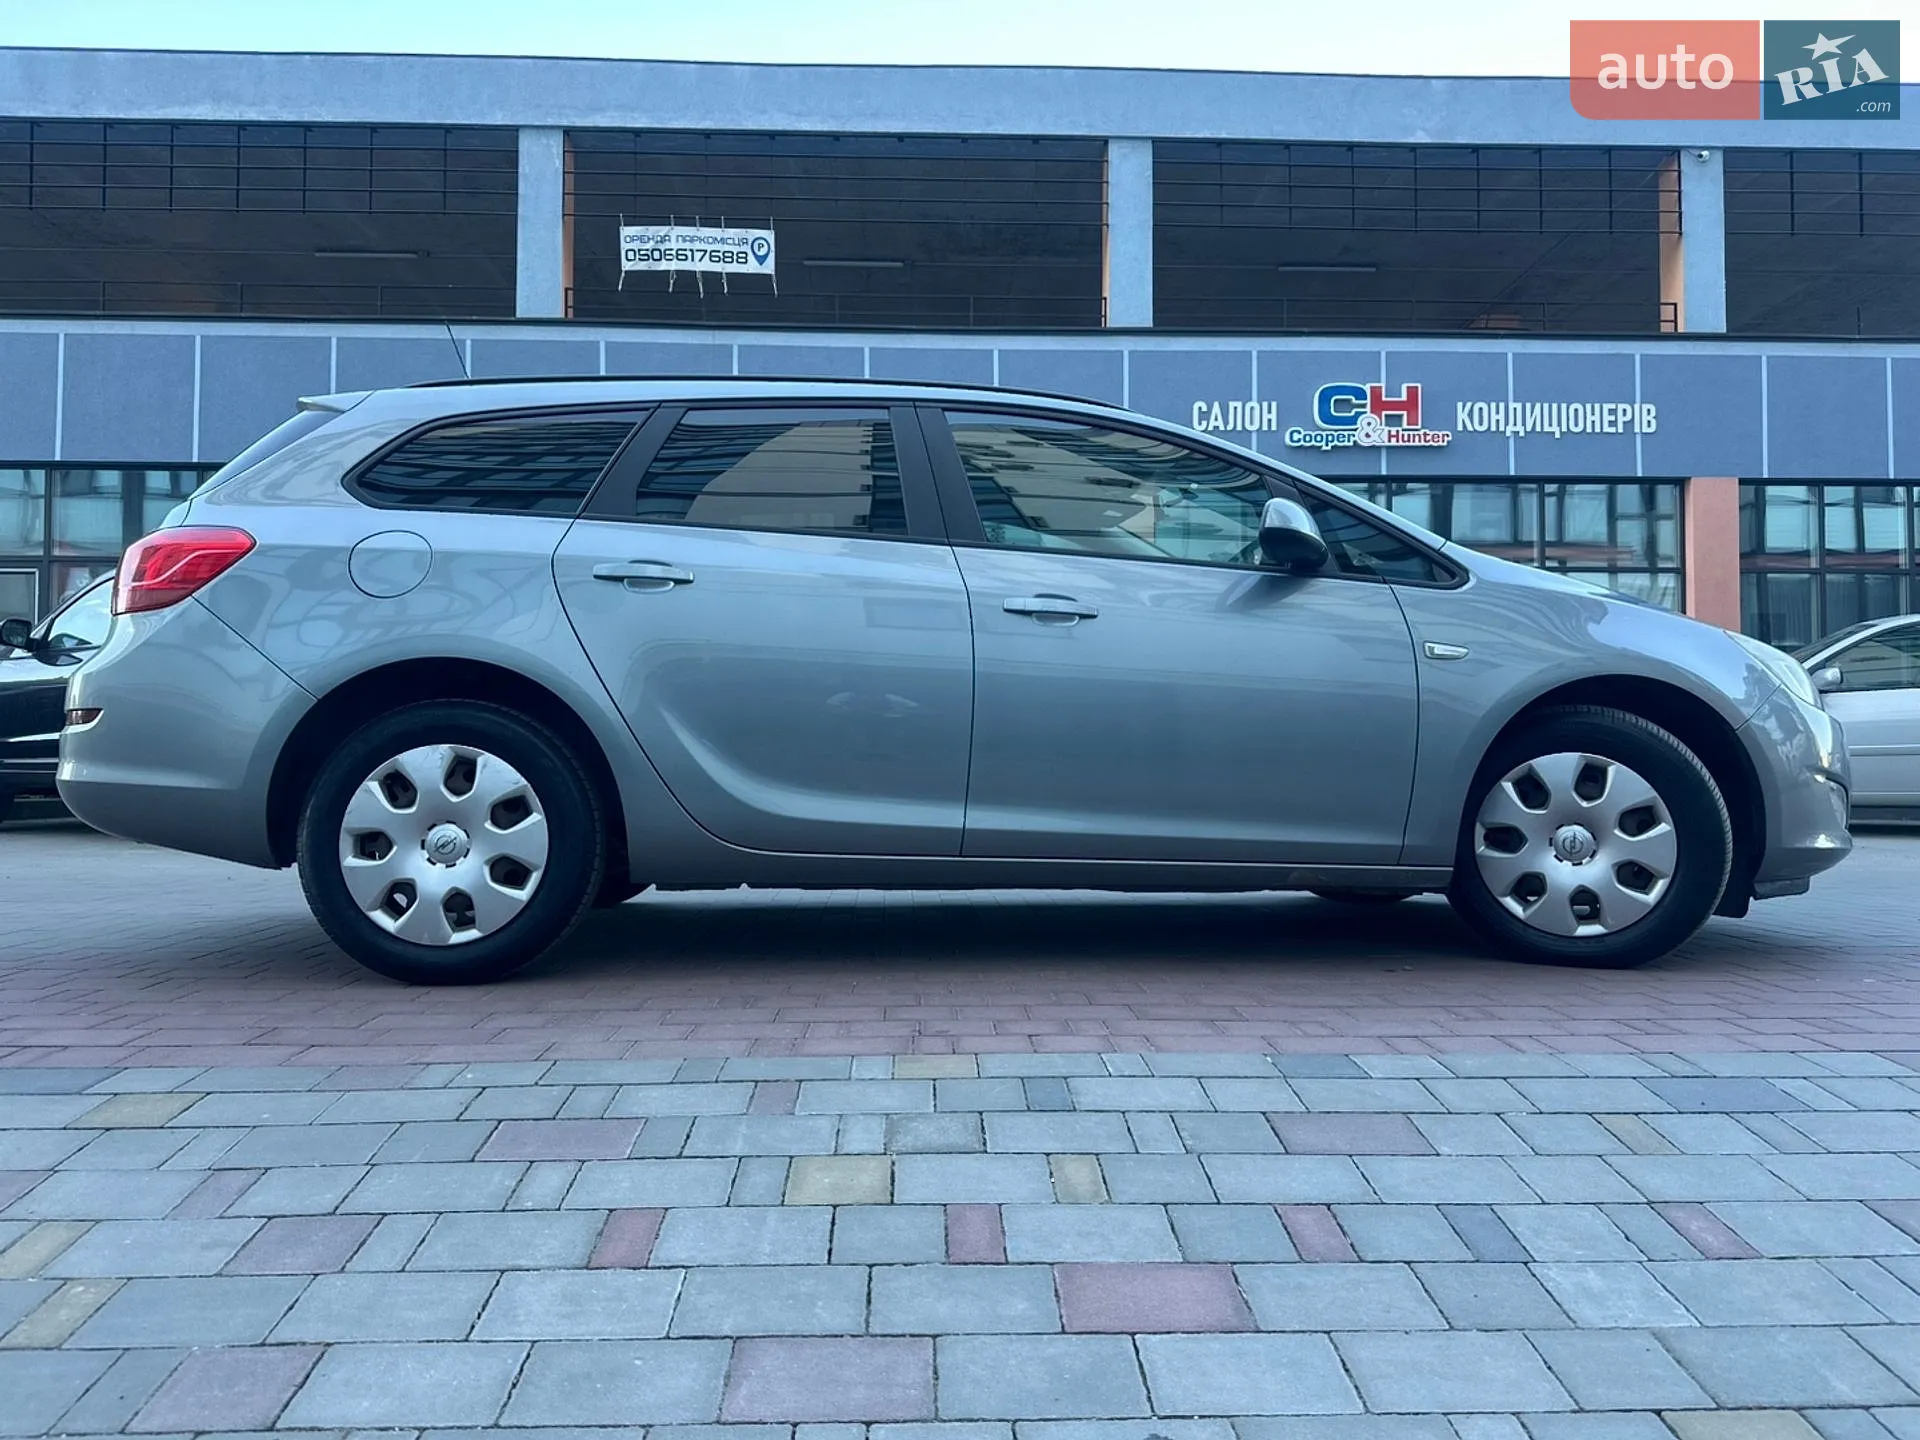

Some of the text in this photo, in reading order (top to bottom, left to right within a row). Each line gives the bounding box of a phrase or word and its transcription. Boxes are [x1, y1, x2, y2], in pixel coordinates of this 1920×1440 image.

[624, 234, 749, 247] ОРЕНДА ПАРКОМІСЦЯ
[625, 248, 749, 265] 0506617688
[1192, 400, 1657, 438] САЛОН КОНДИЦІОНЕРІВ
